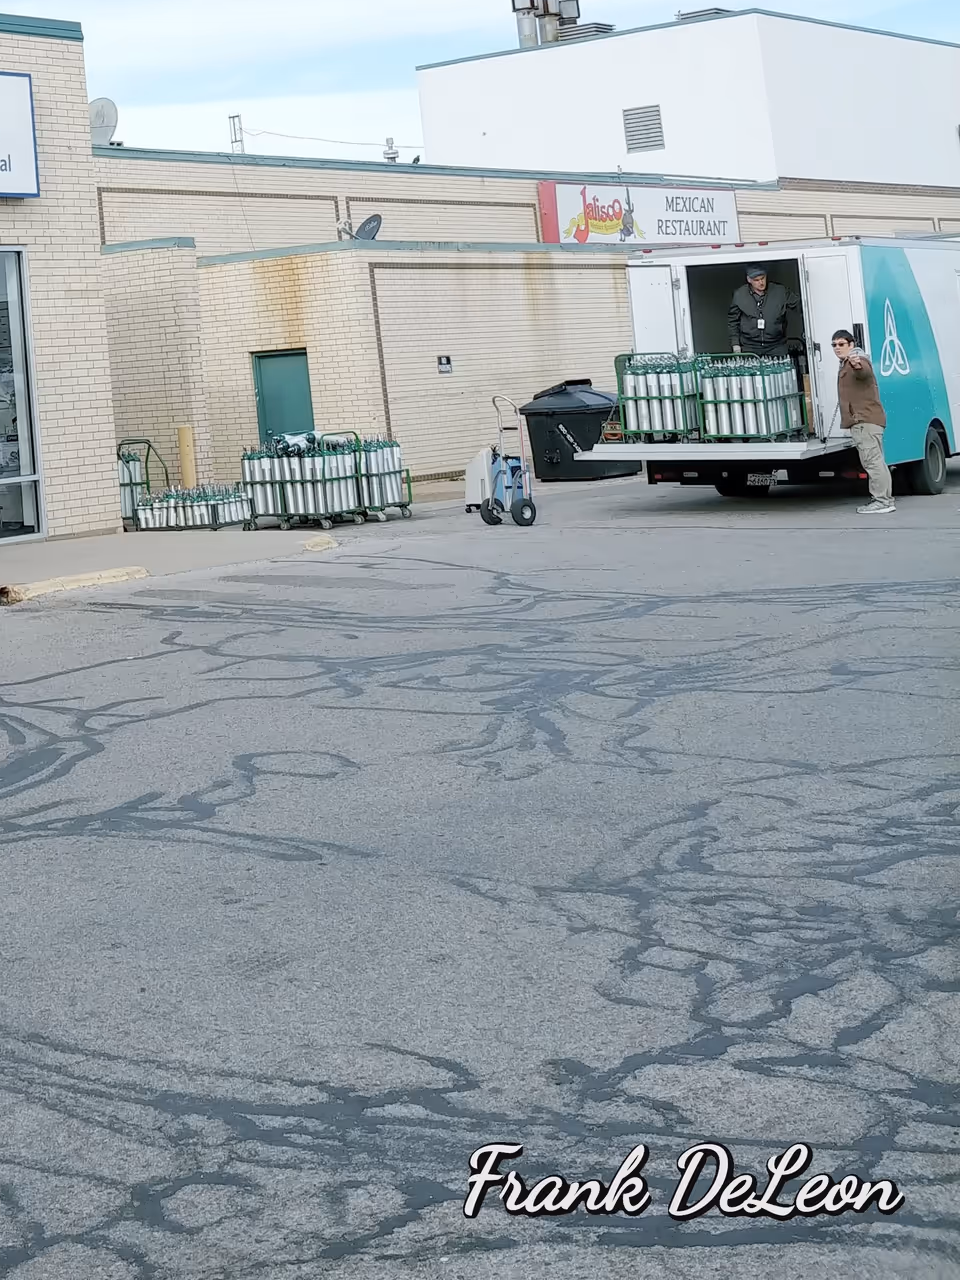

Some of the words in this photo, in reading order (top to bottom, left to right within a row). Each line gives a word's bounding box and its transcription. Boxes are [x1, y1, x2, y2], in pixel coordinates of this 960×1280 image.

[665, 196, 714, 213] MEXICAN
[573, 185, 623, 244] Jalisco
[657, 219, 728, 236] RESTAURANT
